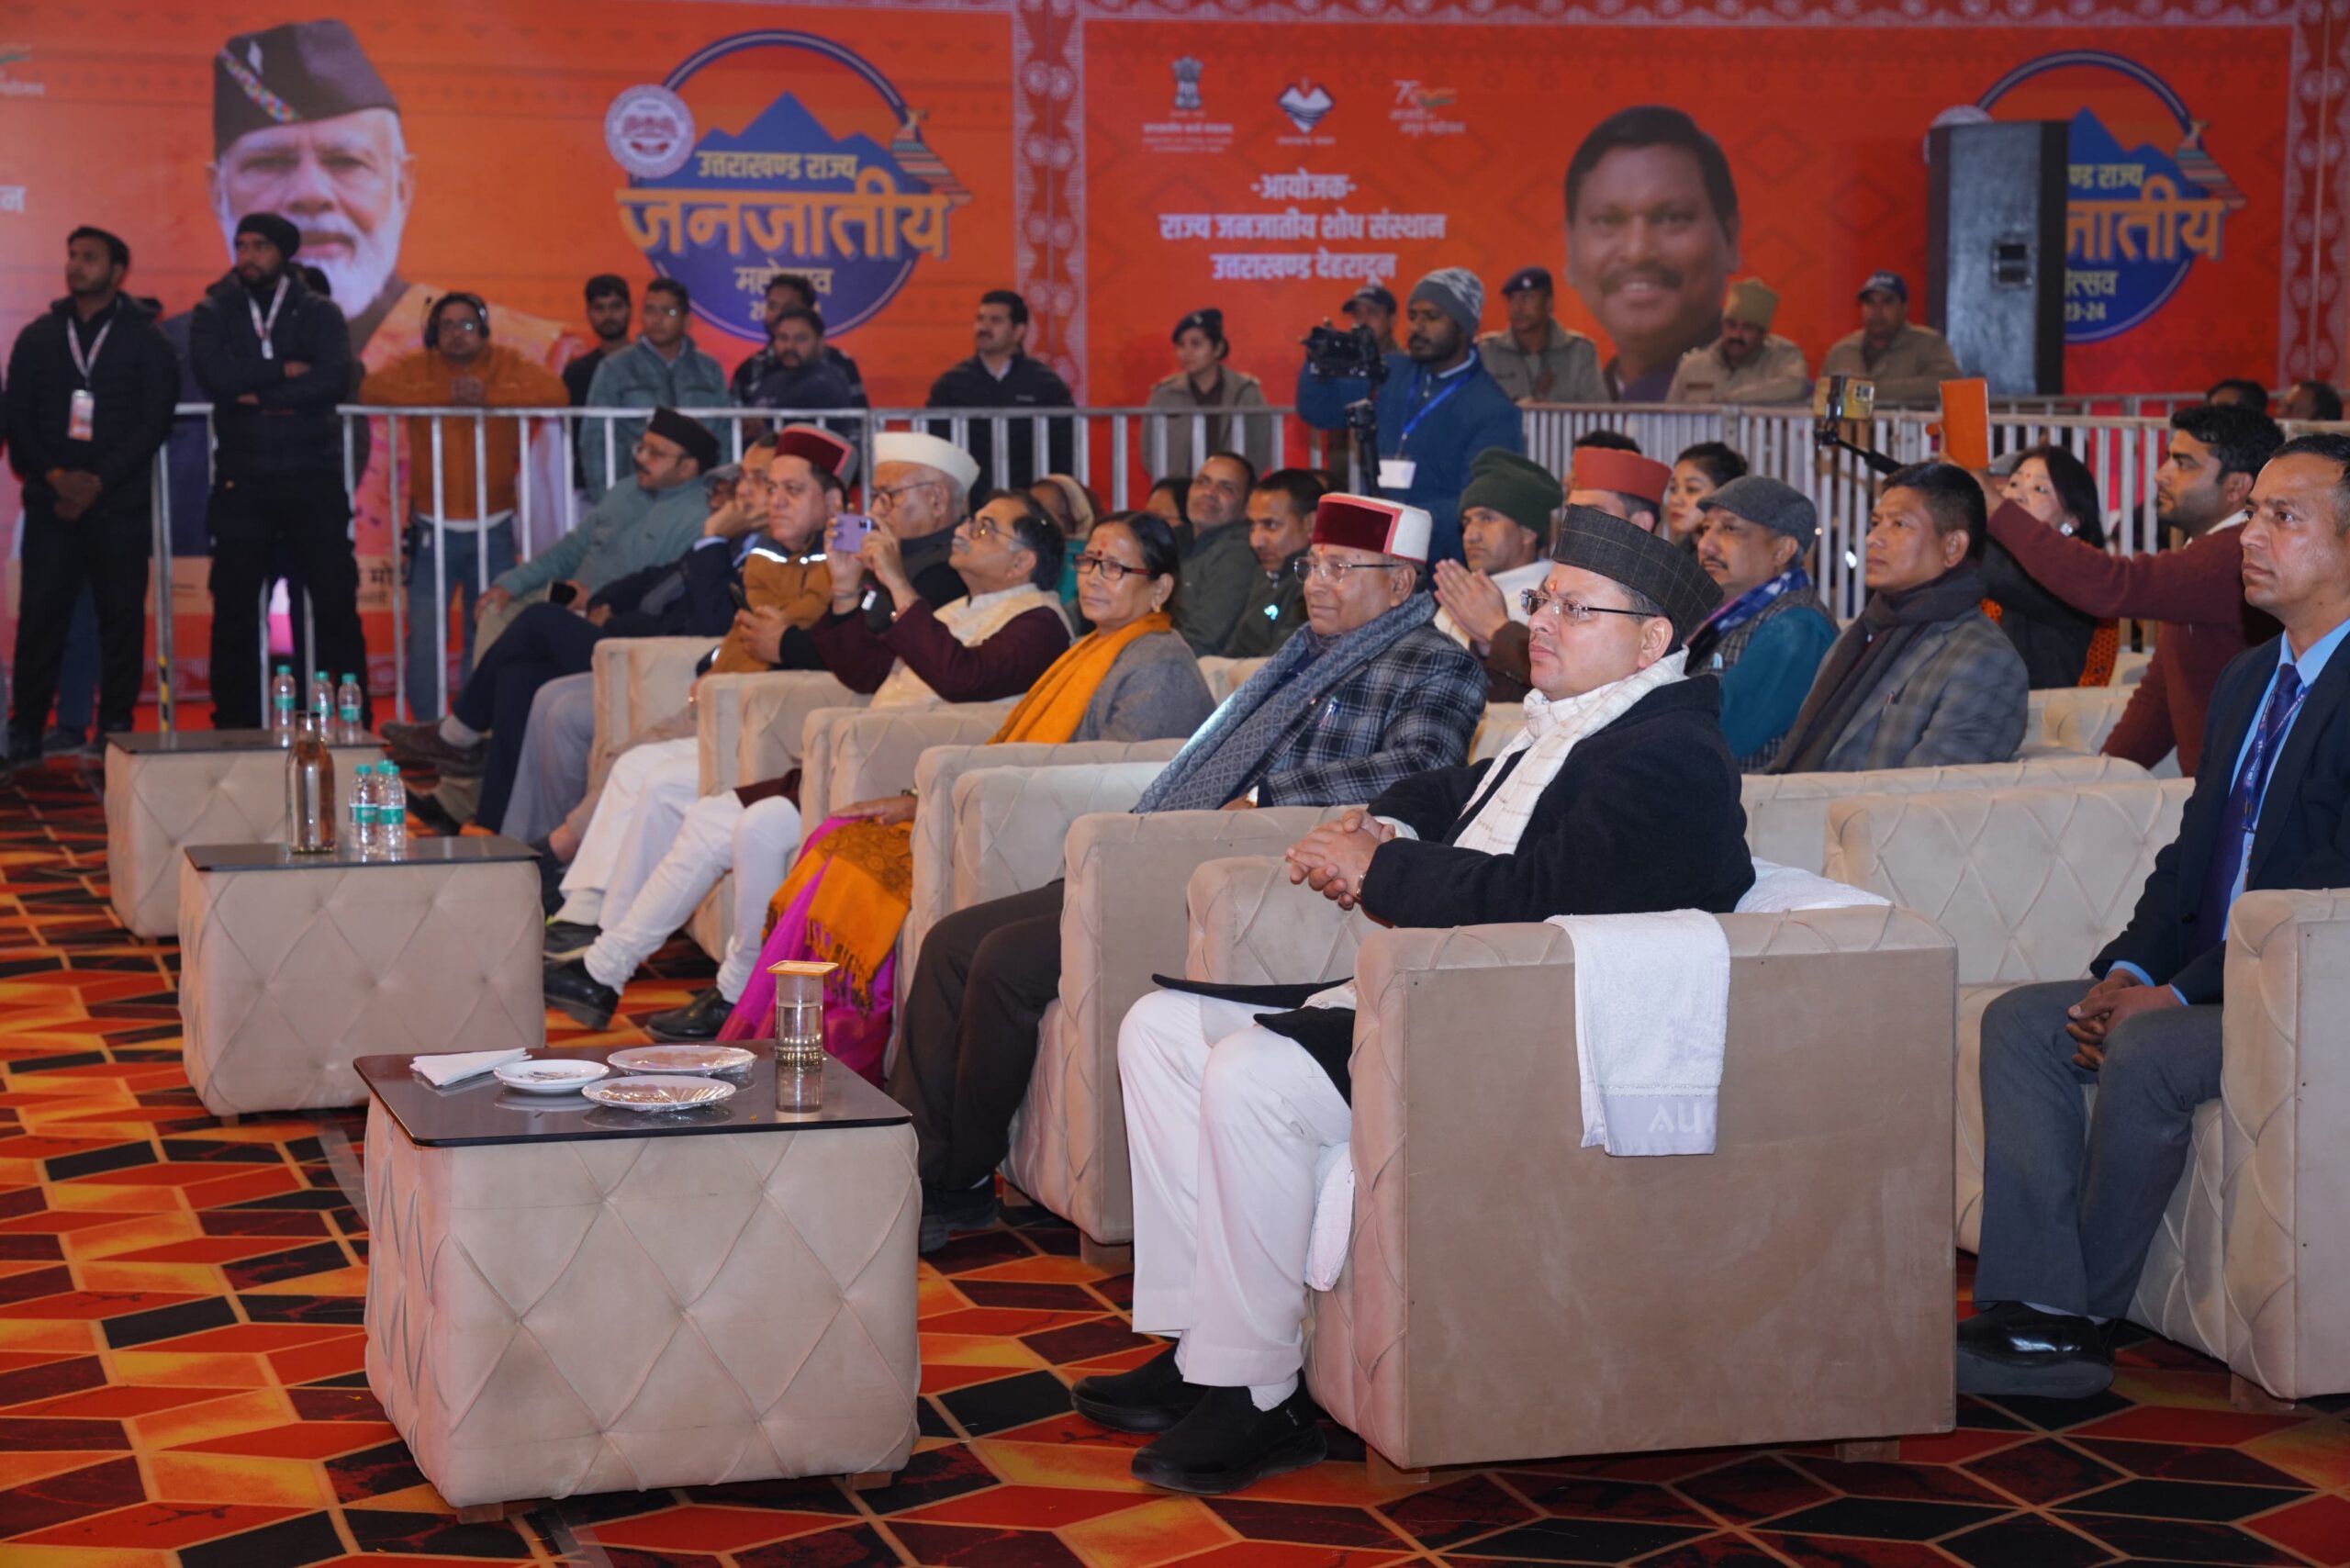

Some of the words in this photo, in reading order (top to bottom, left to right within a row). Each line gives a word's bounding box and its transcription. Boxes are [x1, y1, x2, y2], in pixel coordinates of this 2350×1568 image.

[696, 151, 801, 179] उत्तराखण्ड
[805, 153, 857, 180] राज्य
[2098, 163, 2144, 188] राज्य
[614, 166, 951, 260] जनजातीय
[1158, 213, 1211, 240] राज्य
[1214, 207, 1317, 240] जनजातीय
[1321, 207, 1364, 240] शोध
[1368, 207, 1448, 240] संस्थान
[1209, 252, 1311, 279] उत्तराखण्ड
[1315, 246, 1397, 285] देहरादून
